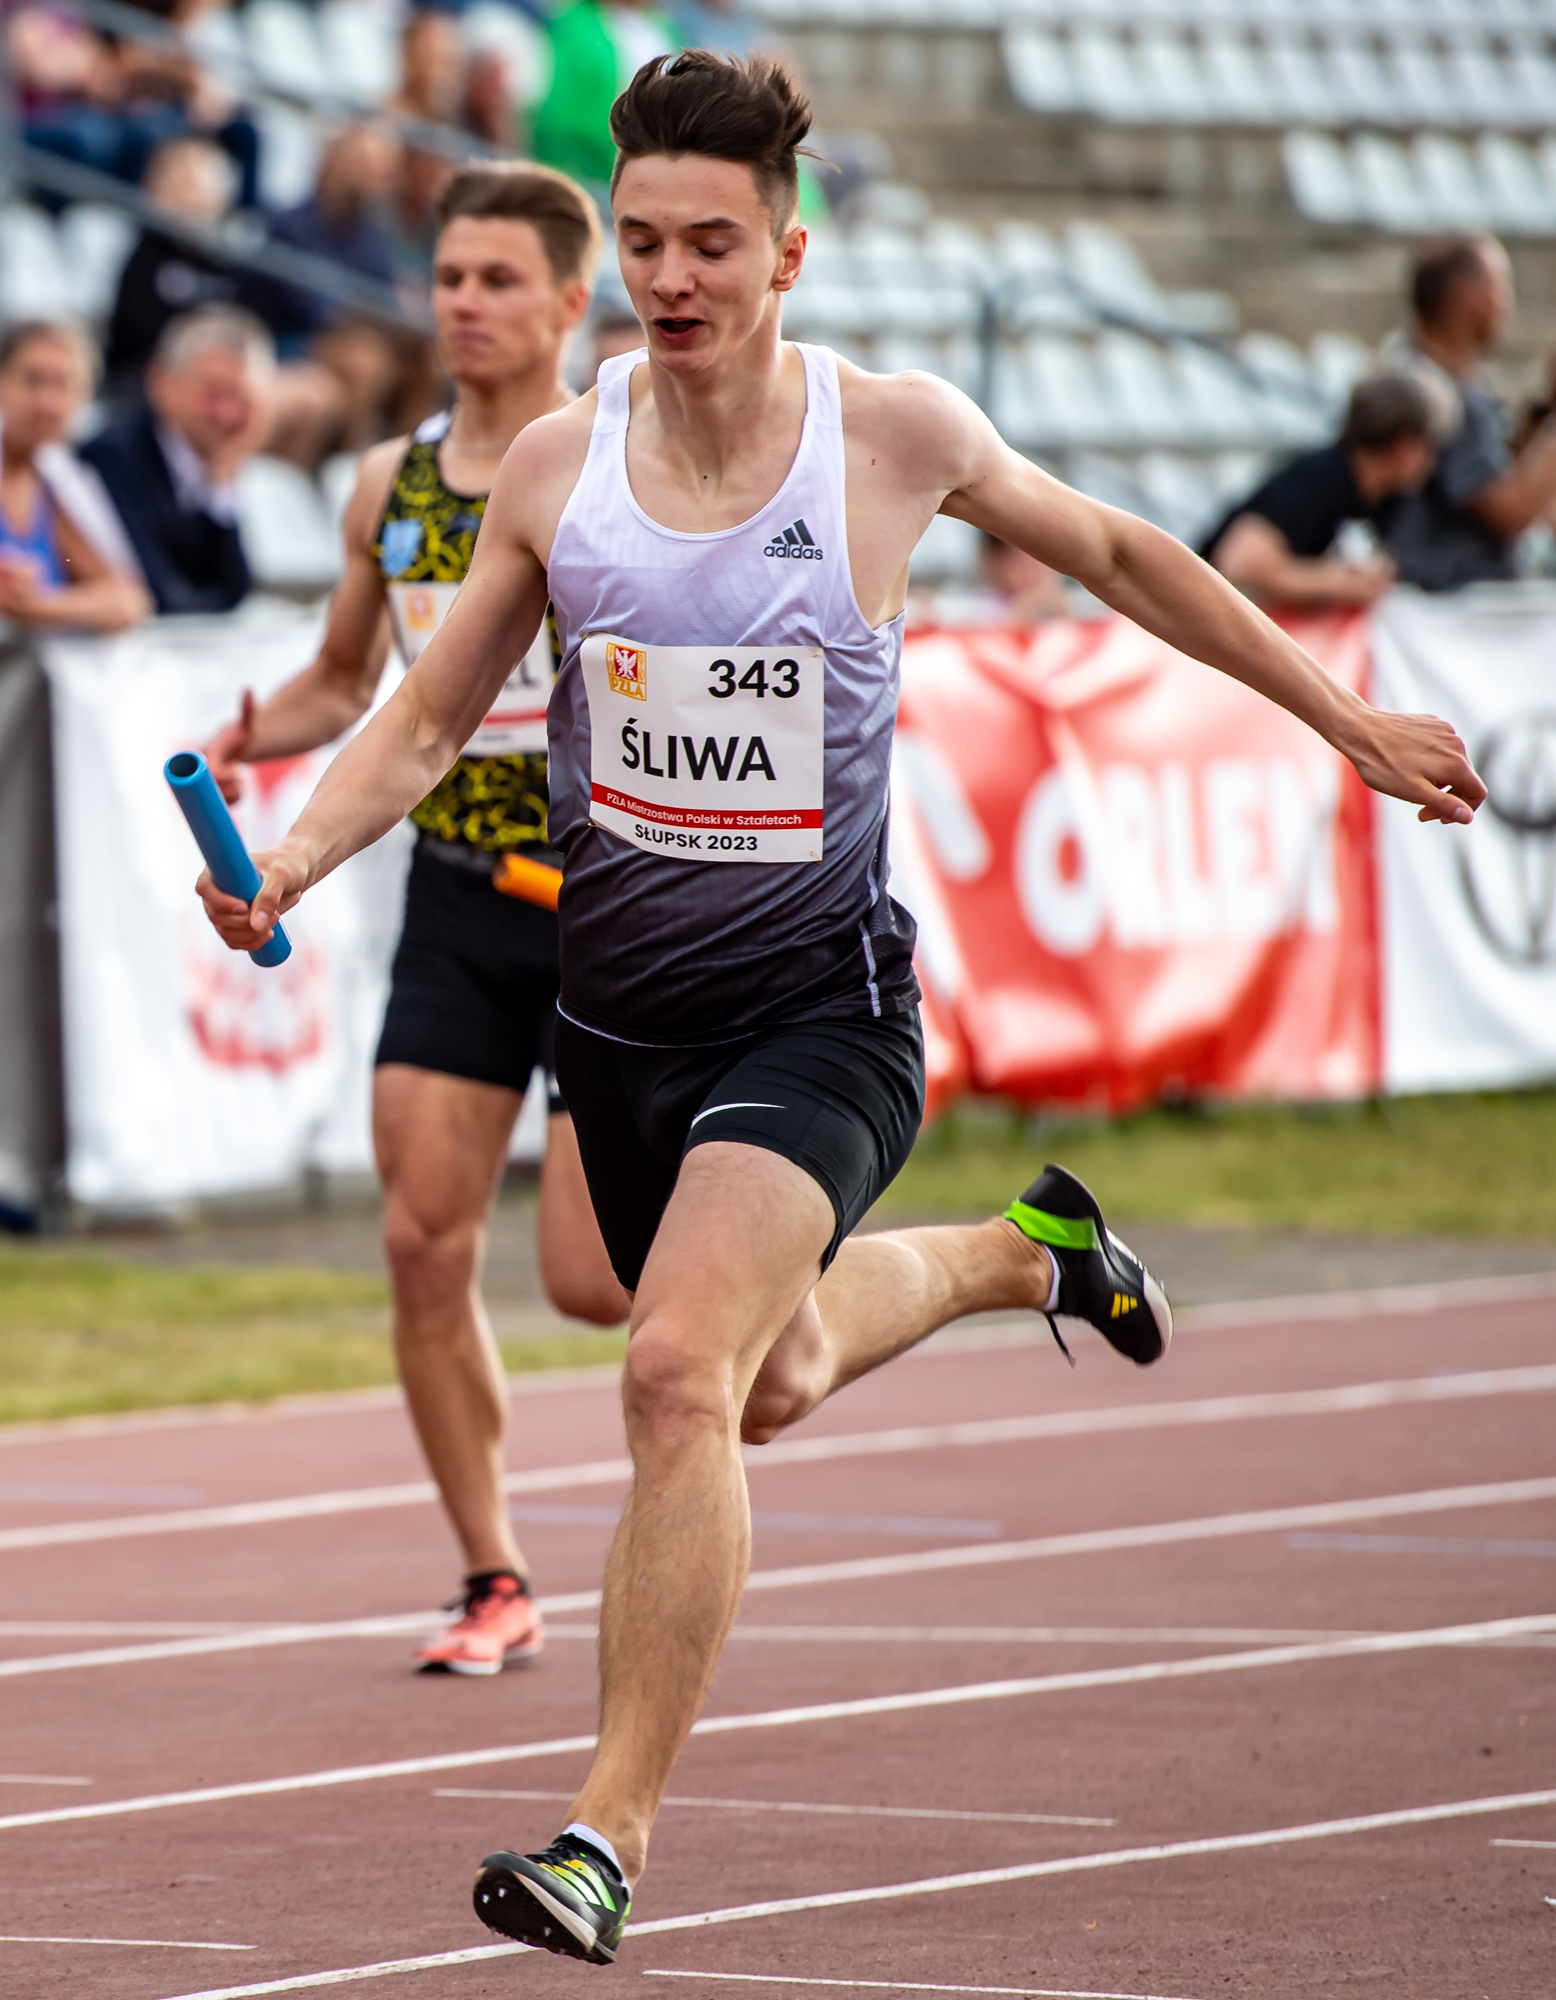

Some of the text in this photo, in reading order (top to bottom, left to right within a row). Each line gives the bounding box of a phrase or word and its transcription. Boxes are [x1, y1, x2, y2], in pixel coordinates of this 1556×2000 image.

[764, 543, 824, 560] adidas
[610, 677, 645, 699] PZLA
[708, 658, 801, 699] 343
[621, 717, 777, 782] ŚLIWA
[606, 792, 802, 826] PZLA Mistrzostwa Polski w Sztafetach
[634, 824, 758, 851] SŁUPSK 2023
[1015, 760, 1340, 957] ORLEN
